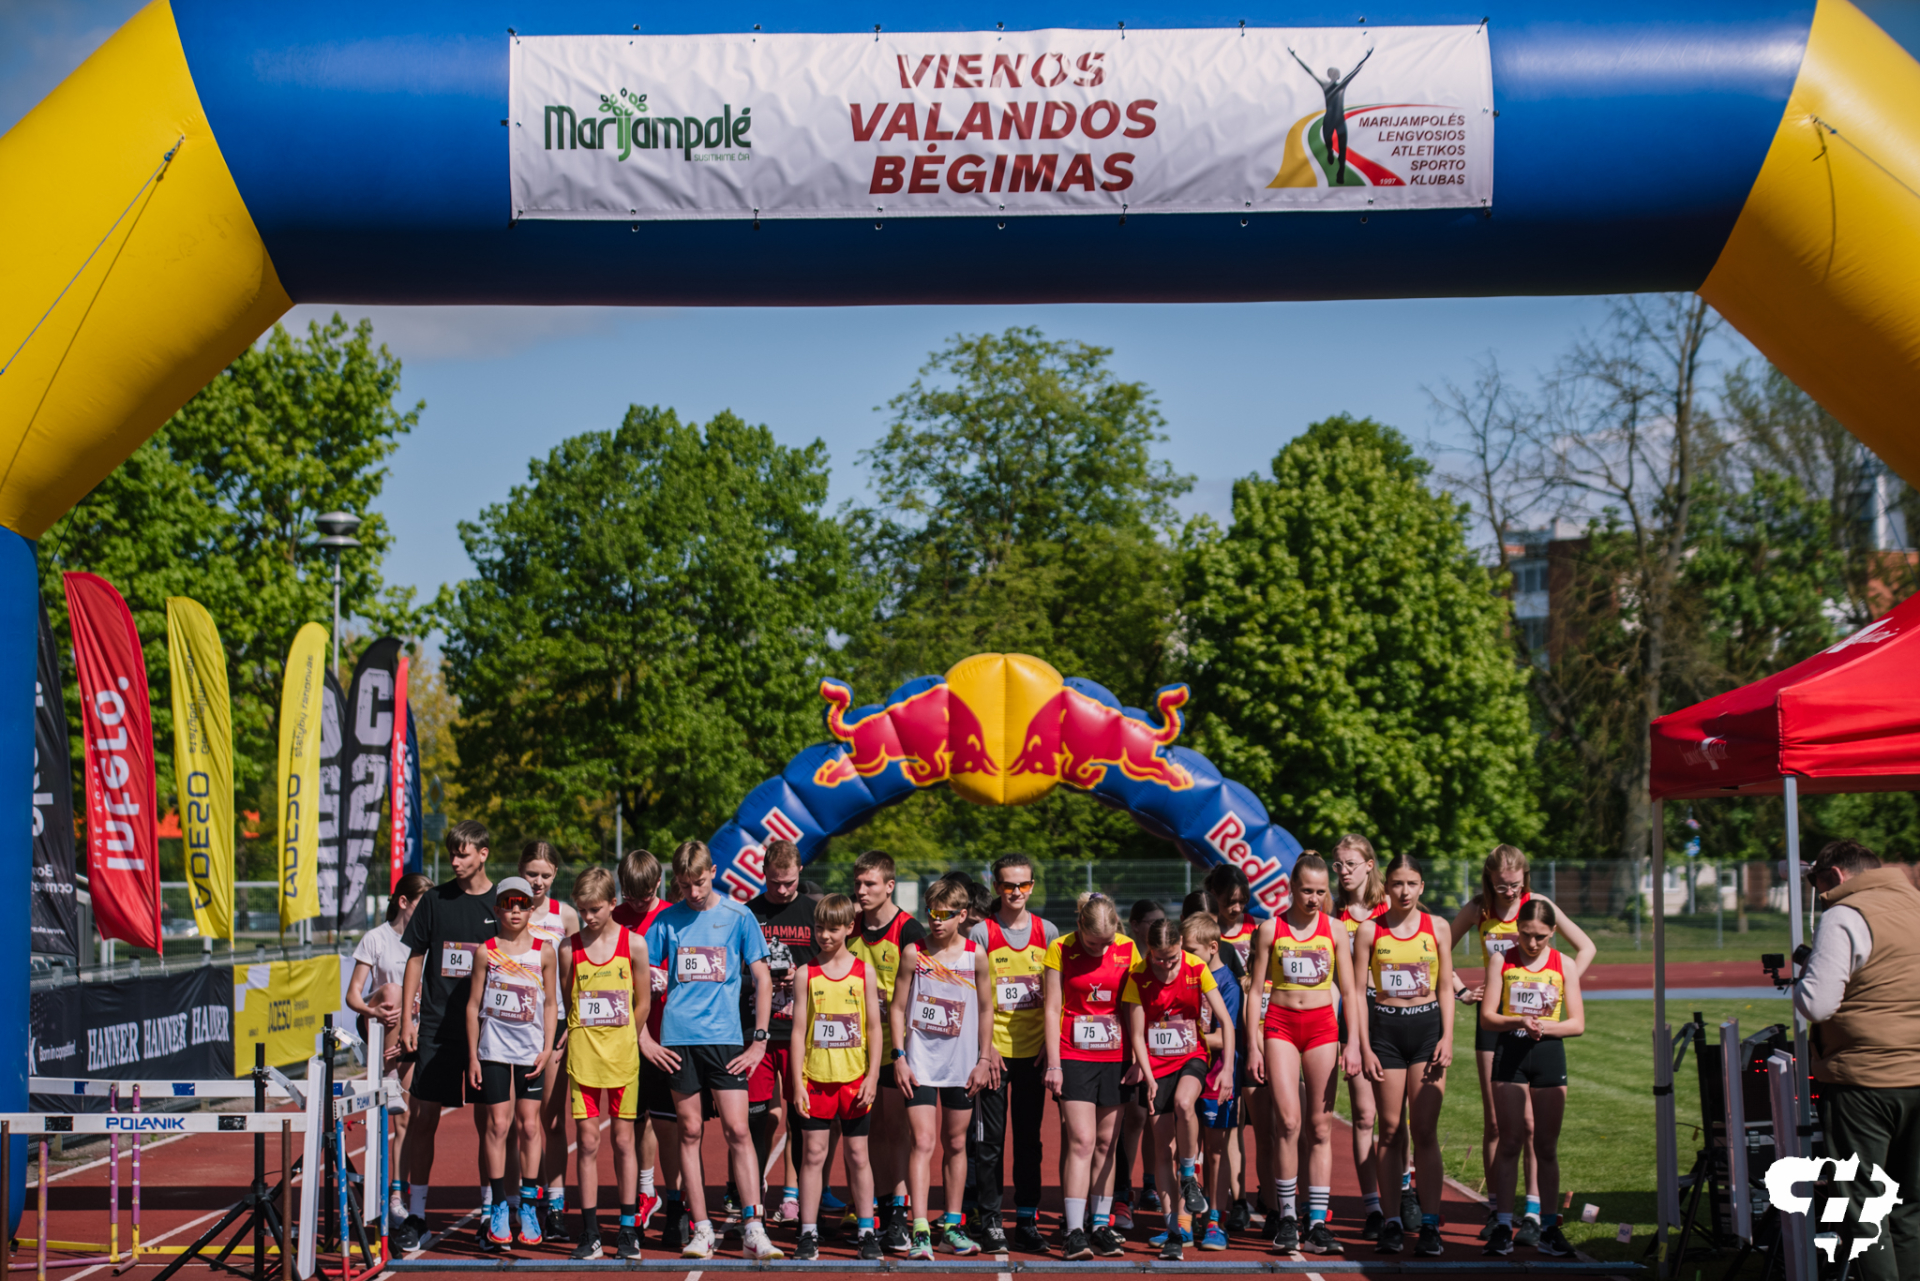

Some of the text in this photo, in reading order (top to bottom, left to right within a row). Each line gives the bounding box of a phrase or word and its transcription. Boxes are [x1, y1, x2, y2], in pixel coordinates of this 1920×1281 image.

[897, 52, 1107, 88] VIENOS
[849, 99, 1159, 142] VALANDOS
[1358, 113, 1466, 128] MARIJAMPOLĖS
[544, 103, 752, 162] Marijampolė
[1377, 130, 1466, 142] LENGVOSIOS
[1391, 144, 1466, 157] ATLETIKOS
[868, 143, 1136, 194] BĖGIMAS
[1410, 159, 1466, 171] SPORTO
[1410, 173, 1466, 186] KLUBAS
[1208, 815, 1278, 885] Red
[450, 953, 462, 966] 84
[685, 957, 698, 970] 85
[1290, 961, 1303, 974] 81
[1389, 974, 1402, 987] 76
[495, 993, 509, 1007] 97
[1005, 987, 1018, 1000] 83
[1517, 991, 1535, 1004] 102
[588, 1002, 600, 1015] 78
[922, 1006, 936, 1020] 98
[1401, 1003, 1431, 1015] NIKE
[822, 1024, 835, 1037] 79
[1083, 1026, 1095, 1039] 75
[1155, 1032, 1172, 1045] 107
[87, 1021, 140, 1072] HANNER
[106, 1116, 185, 1130] POLANIK
